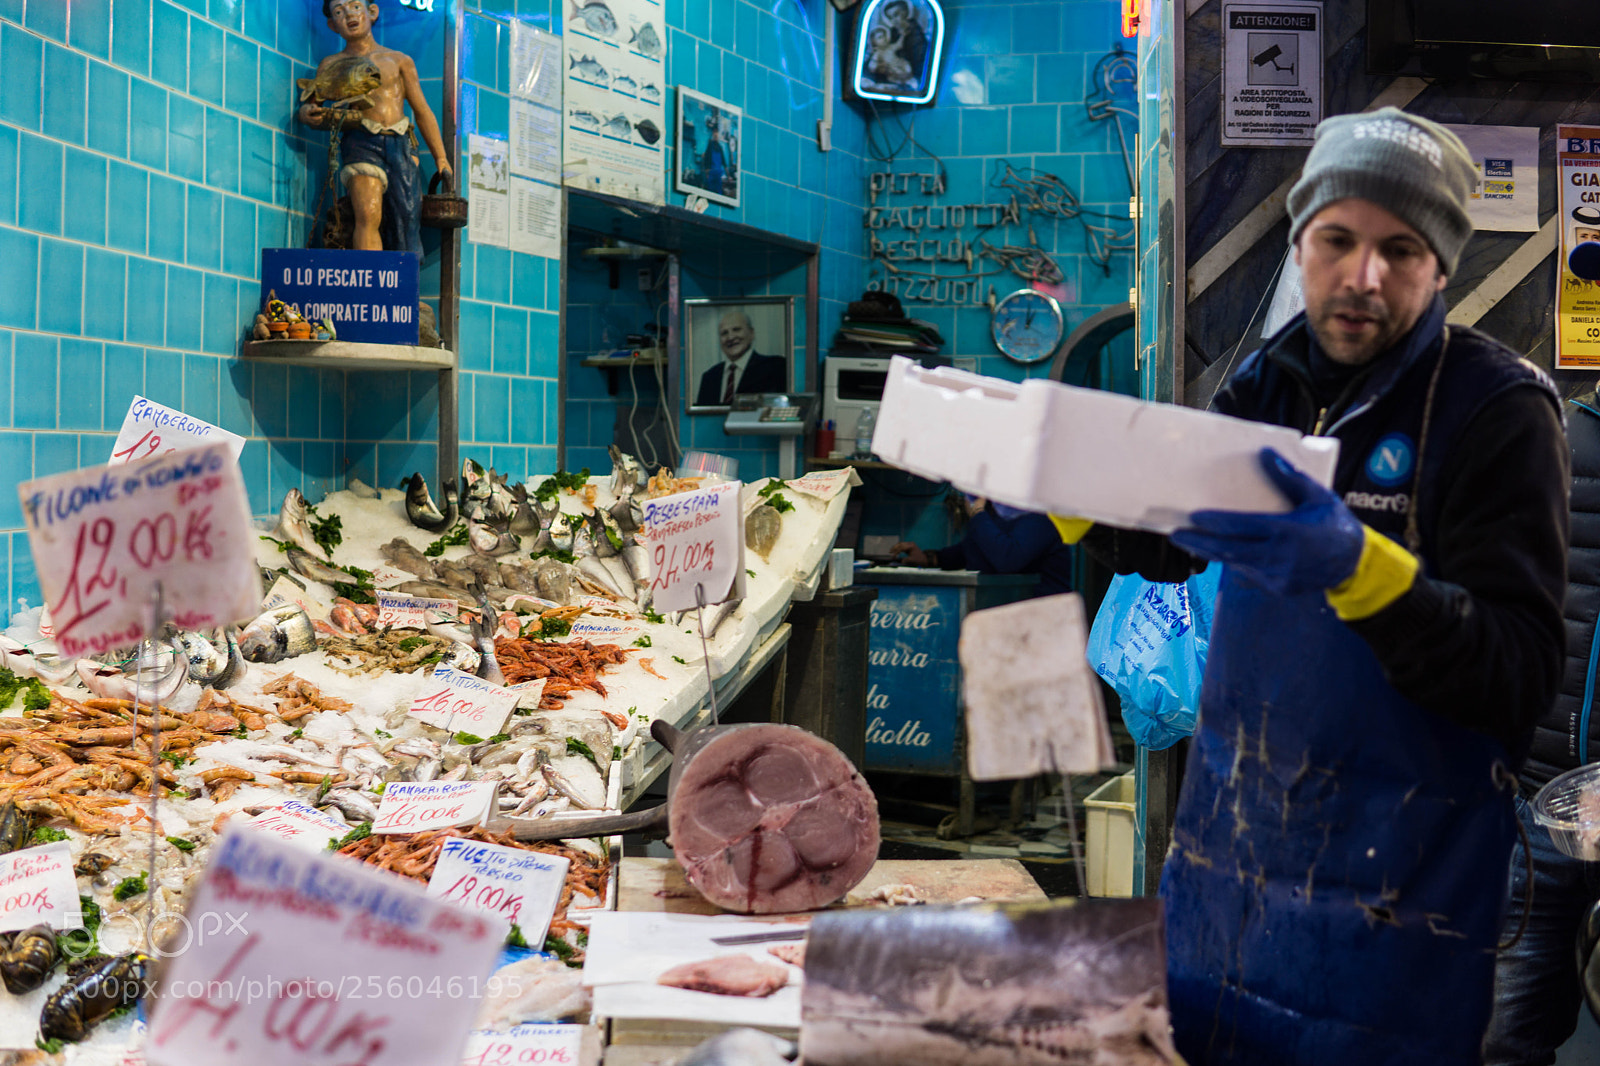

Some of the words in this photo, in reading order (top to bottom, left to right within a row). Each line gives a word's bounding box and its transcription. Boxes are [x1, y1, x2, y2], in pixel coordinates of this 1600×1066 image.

[1235, 15, 1311, 27] ATTENZIONE!
[1240, 96, 1313, 104] VIDEOSORVEGLIANZA
[1234, 109, 1264, 117] RAGIONI
[1273, 110, 1311, 118] SICUREZZA
[1485, 181, 1505, 193] Pago
[283, 267, 292, 286] O
[296, 267, 313, 286] LO
[317, 268, 373, 288] PESCATE
[378, 270, 399, 289] VOI
[304, 302, 369, 322] COMPRATE
[372, 304, 389, 323] DA
[392, 305, 412, 324] NOI
[1375, 446, 1403, 472] N
[435, 668, 489, 693] FRITTURA
[389, 783, 439, 797] GAMBERI
